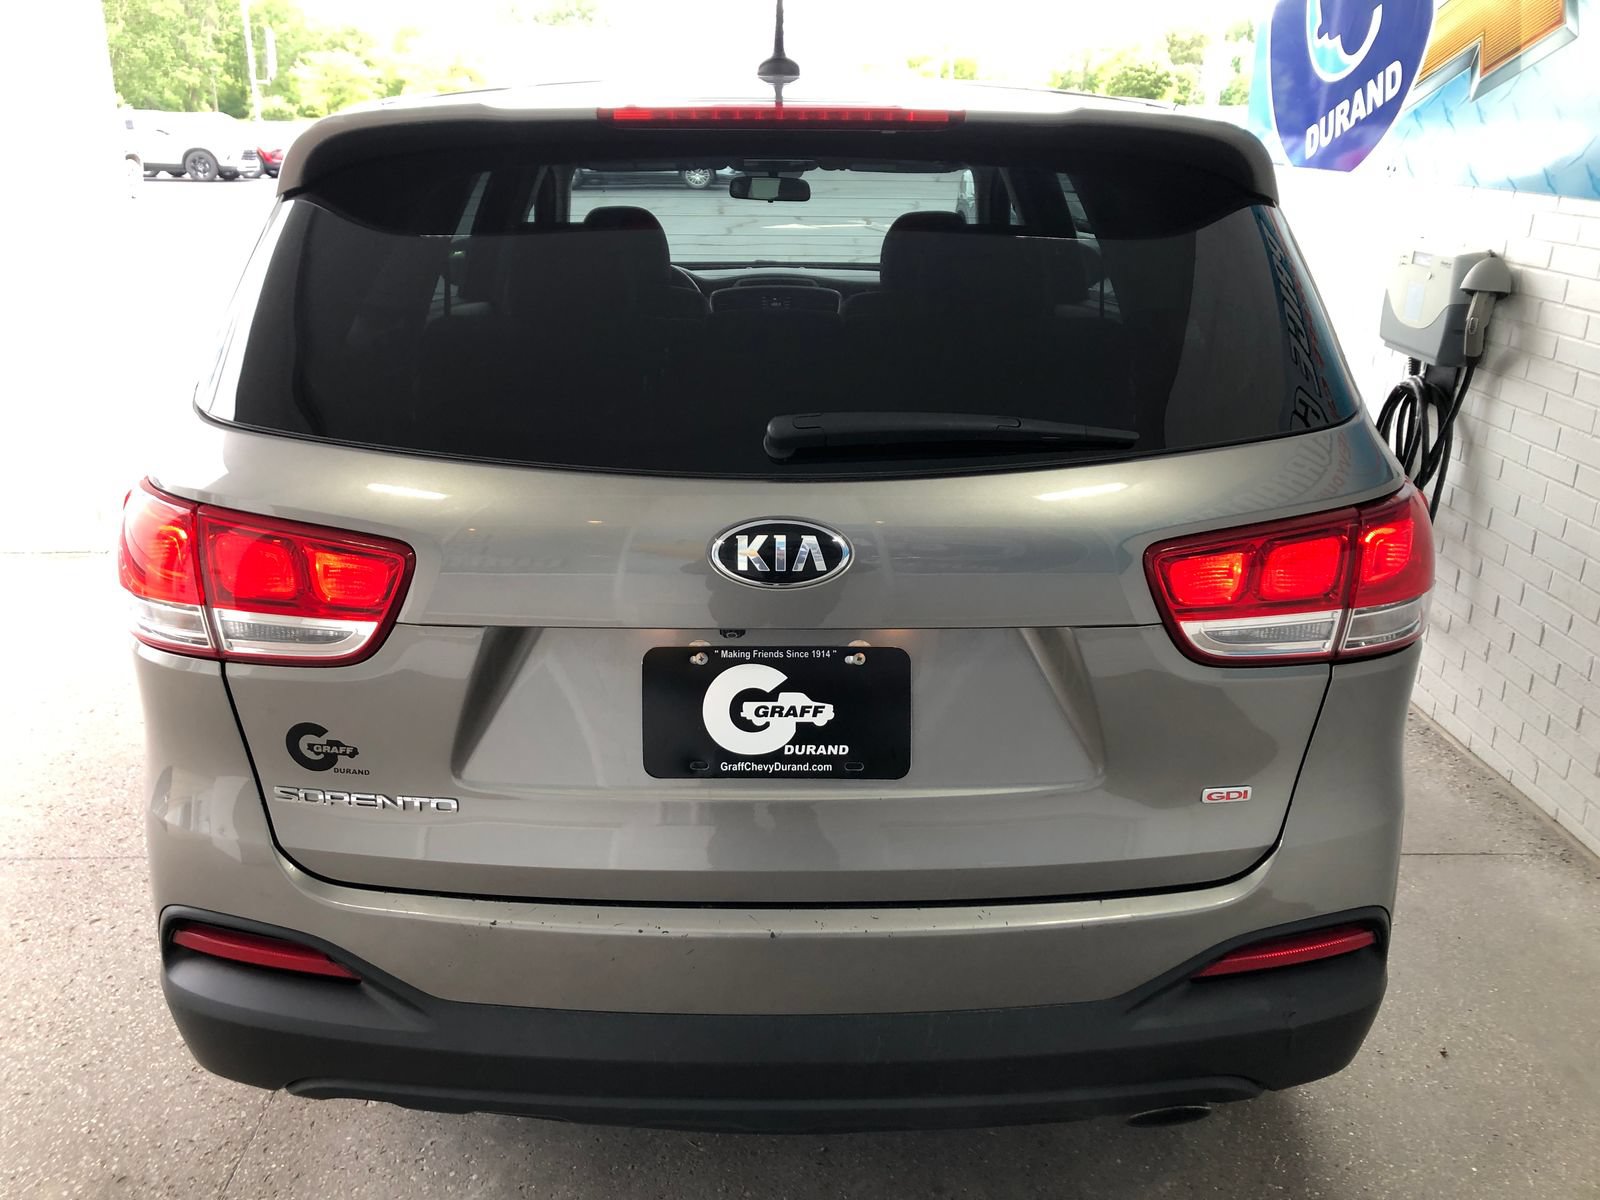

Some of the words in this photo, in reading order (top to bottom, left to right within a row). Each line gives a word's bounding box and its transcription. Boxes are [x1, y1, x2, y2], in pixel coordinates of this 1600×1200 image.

[1305, 61, 1402, 160] DURAND
[736, 534, 827, 572] KIA
[721, 650, 750, 660] Making
[753, 650, 783, 658] Friends
[786, 650, 809, 658] Since
[812, 650, 830, 658] 1914
[754, 705, 826, 718] GRAFF
[313, 744, 354, 755] GRAFF
[784, 745, 849, 755] DURAND
[333, 767, 370, 776] DURAND
[720, 761, 832, 772] GraffChevyDurand.com
[274, 786, 459, 813] SORENTO
[1206, 790, 1248, 801] GDI
